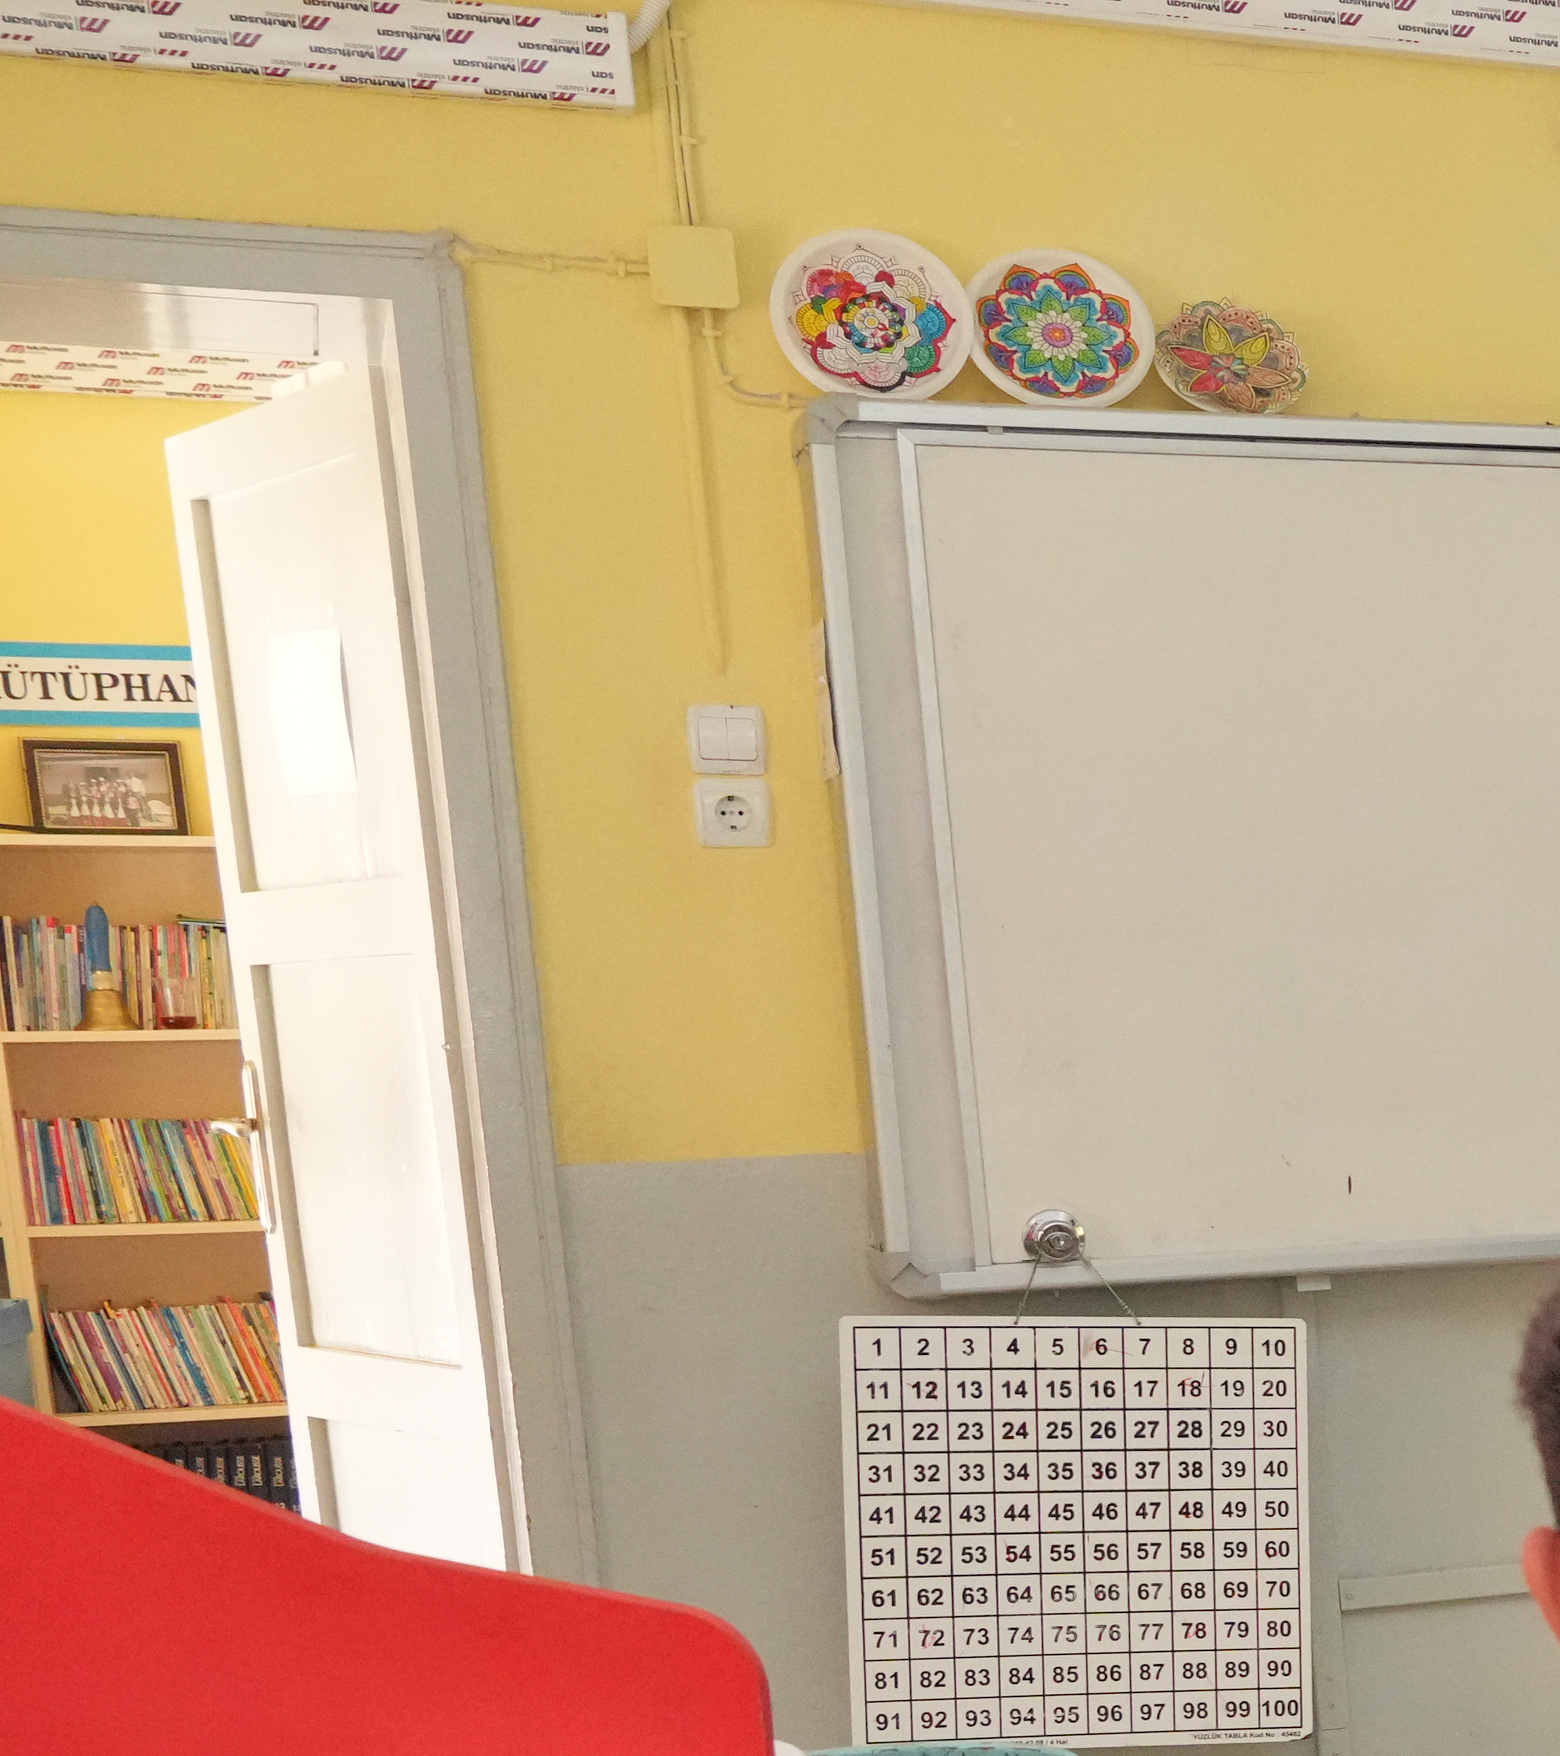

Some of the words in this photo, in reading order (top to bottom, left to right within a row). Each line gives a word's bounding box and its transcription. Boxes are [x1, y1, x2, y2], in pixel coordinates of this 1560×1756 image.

[0, 664, 196, 702] ÜTÜPHAN
[872, 1338, 881, 1356] 1
[917, 1338, 929, 1355] 2
[963, 1339, 974, 1356] 3
[1007, 1338, 1020, 1355] 4
[1052, 1338, 1064, 1355] 5
[1095, 1338, 1108, 1355] 6
[1139, 1338, 1150, 1355] 7
[1183, 1338, 1194, 1355] 8
[1226, 1338, 1237, 1355] 9
[1262, 1340, 1285, 1356] 10
[867, 1382, 888, 1399] 11
[911, 1381, 938, 1400] 12
[957, 1381, 982, 1399] 13
[1002, 1380, 1028, 1398] 14
[1046, 1381, 1072, 1398] 15
[1090, 1380, 1115, 1398] 16
[1134, 1380, 1158, 1397] 17
[1177, 1380, 1201, 1397] 18
[1221, 1380, 1244, 1397] 19
[1263, 1380, 1287, 1397] 20
[867, 1423, 891, 1441] 21
[912, 1423, 939, 1440] 22
[958, 1422, 984, 1440] 23
[1002, 1422, 1029, 1439] 24
[1047, 1422, 1073, 1439] 25
[1090, 1421, 1116, 1439] 26
[1134, 1421, 1159, 1438] 27
[1177, 1420, 1202, 1438] 28
[1221, 1421, 1245, 1437] 29
[1263, 1420, 1287, 1437] 30
[868, 1465, 892, 1483] 31
[914, 1464, 940, 1482] 32
[959, 1464, 985, 1481] 33
[1004, 1463, 1030, 1481] 34
[1048, 1463, 1073, 1480] 35
[1092, 1462, 1117, 1479] 36
[1135, 1461, 1160, 1479] 37
[1178, 1461, 1203, 1478] 38
[1222, 1461, 1246, 1478] 39
[1263, 1461, 1288, 1477] 40
